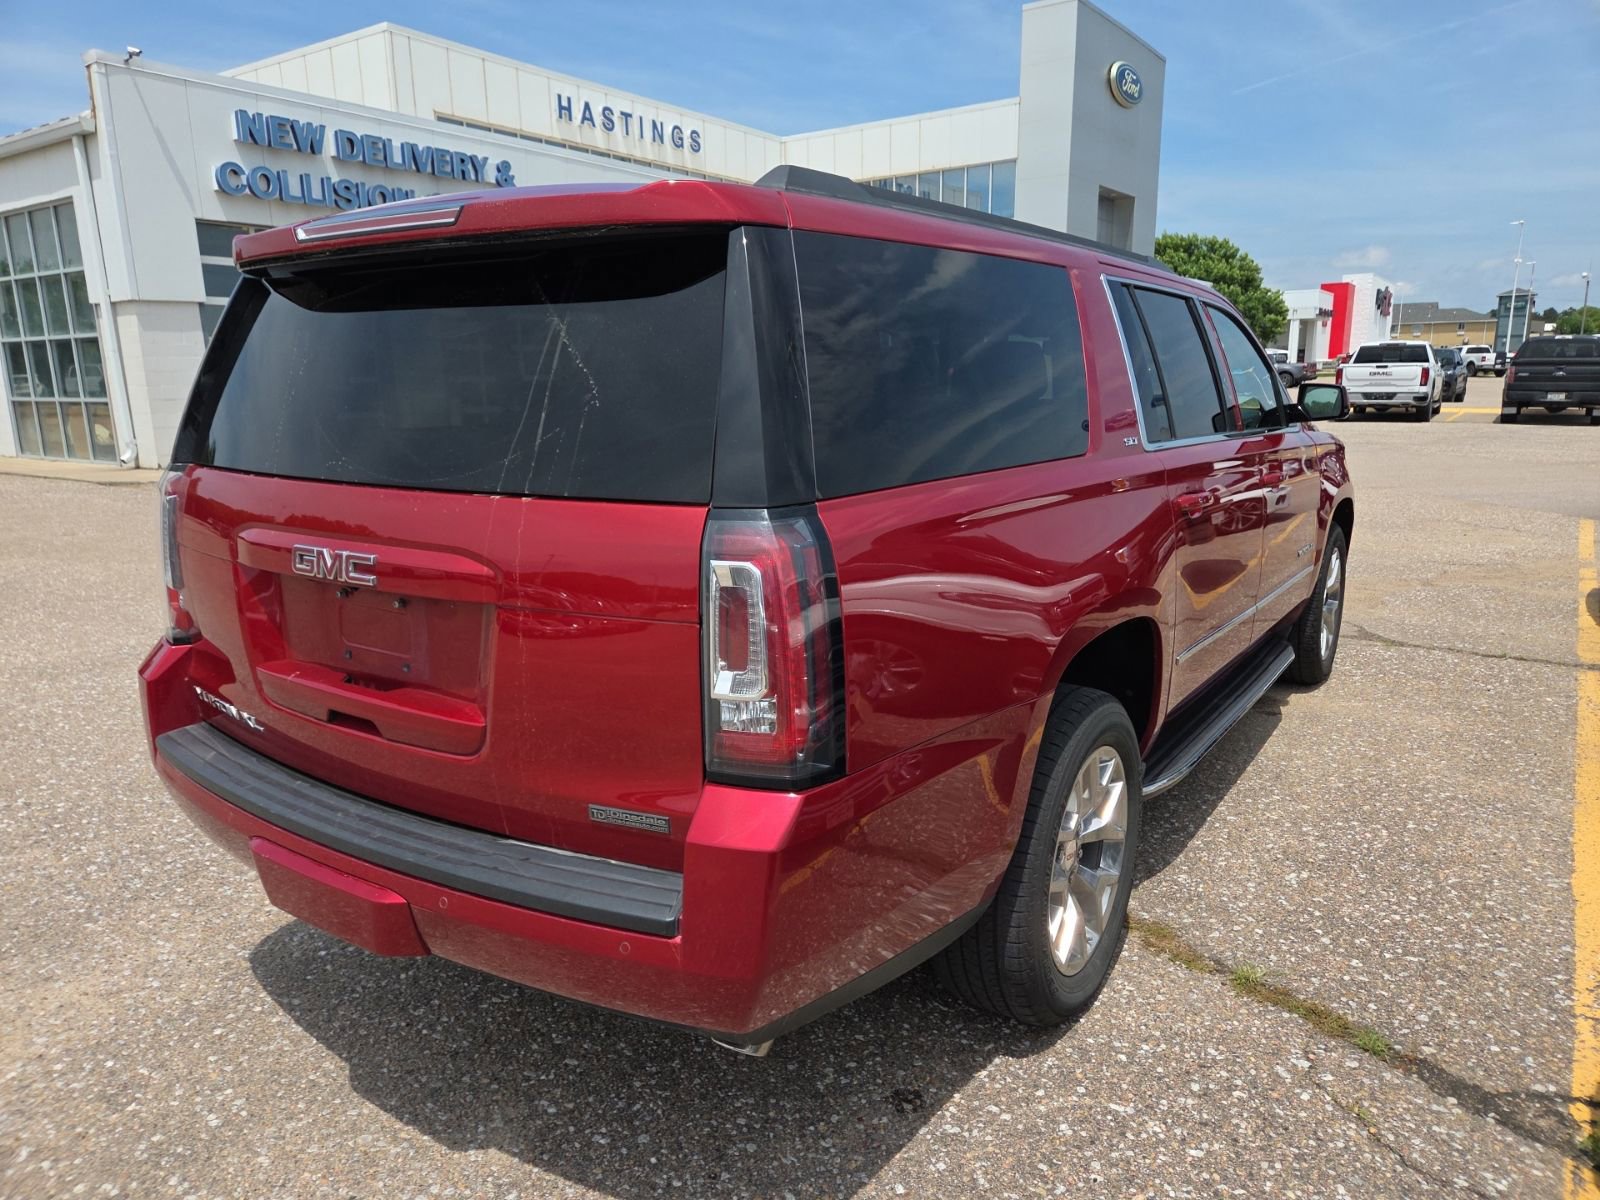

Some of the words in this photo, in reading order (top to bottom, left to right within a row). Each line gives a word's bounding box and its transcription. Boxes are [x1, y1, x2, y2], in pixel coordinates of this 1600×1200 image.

[1122, 69, 1140, 98] Ford
[233, 109, 326, 155] NEW
[332, 129, 489, 184] DELIVERY
[495, 160, 516, 188] &
[557, 93, 701, 153] HASTINGS
[292, 544, 377, 586] GMC
